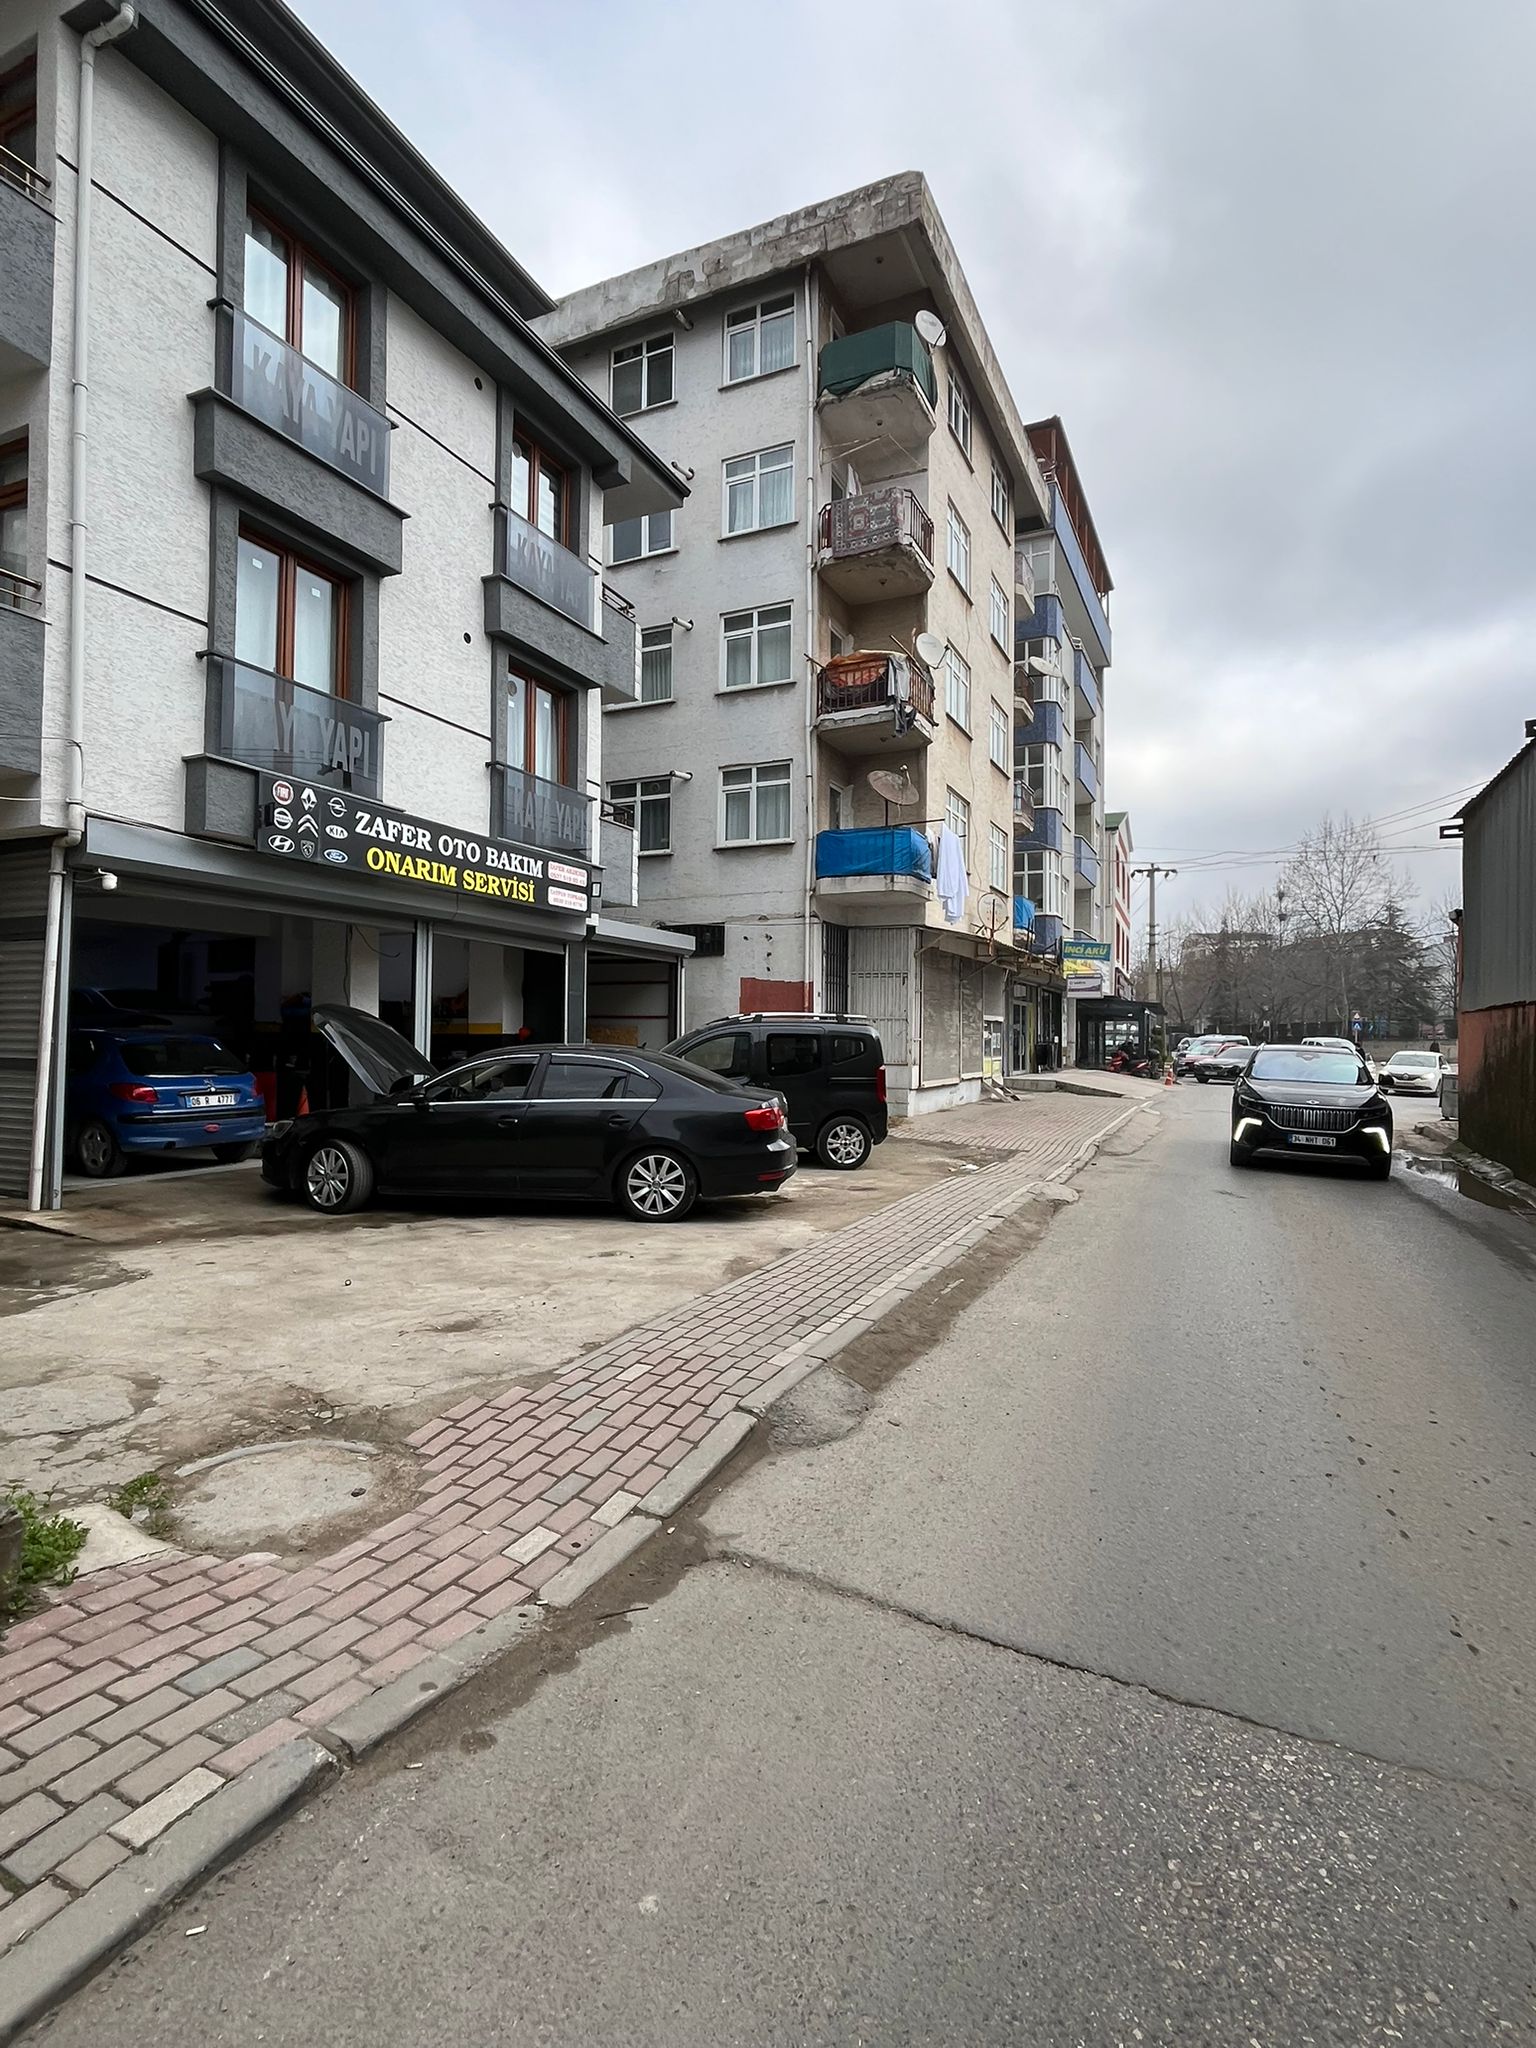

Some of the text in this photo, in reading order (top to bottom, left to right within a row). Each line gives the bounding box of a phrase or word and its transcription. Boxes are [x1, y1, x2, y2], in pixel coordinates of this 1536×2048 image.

[329, 827, 345, 836] KIA
[354, 811, 544, 878] ZAFER OTO BAKIM
[366, 846, 535, 903] ONARIM SERVİSİ
